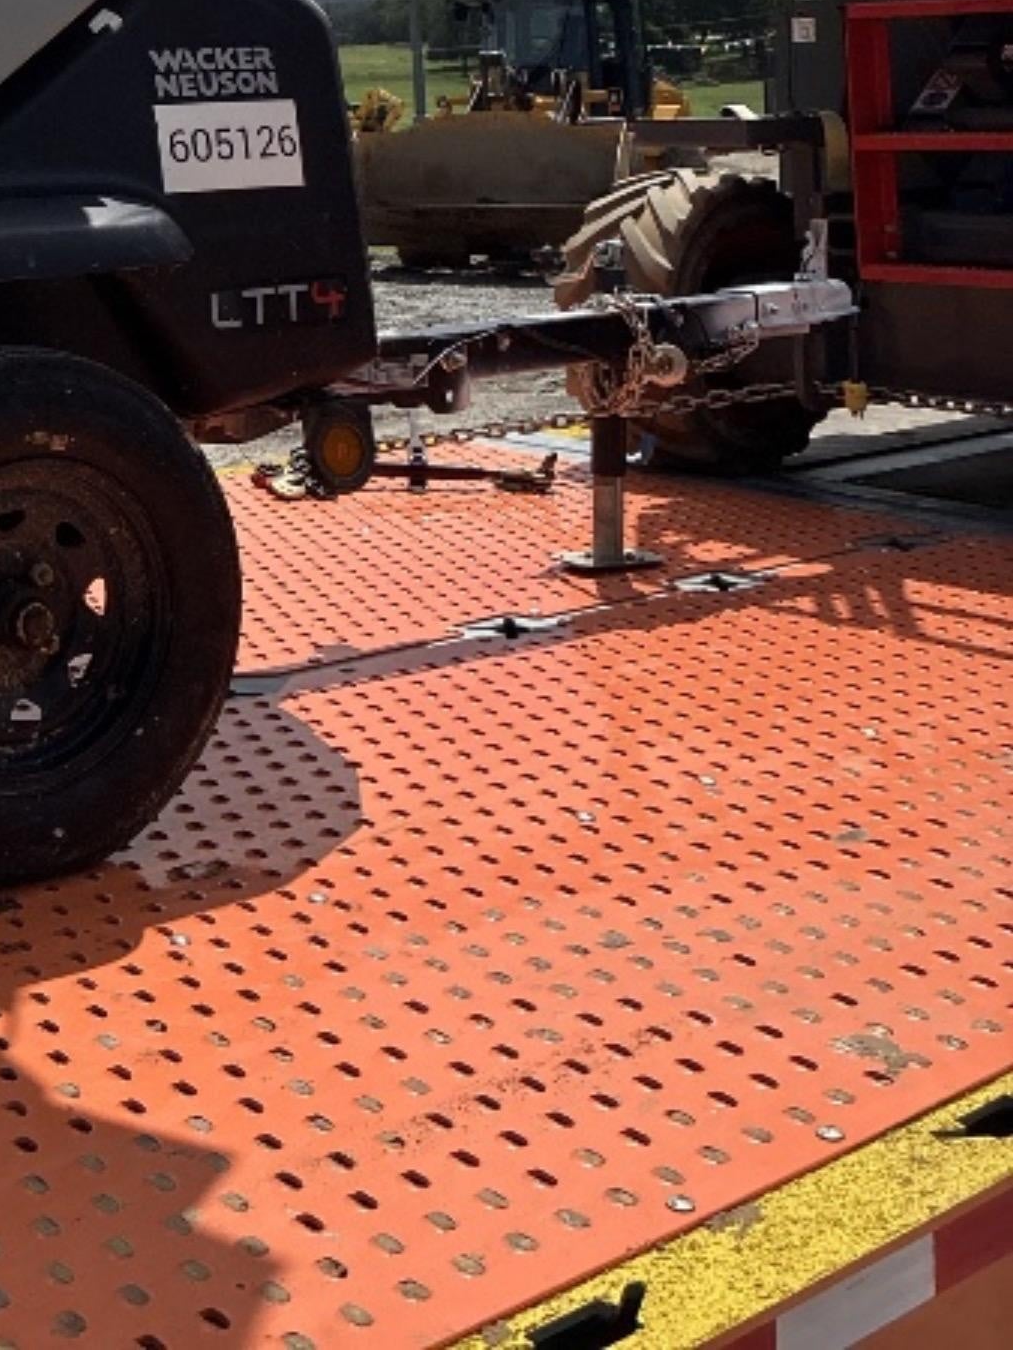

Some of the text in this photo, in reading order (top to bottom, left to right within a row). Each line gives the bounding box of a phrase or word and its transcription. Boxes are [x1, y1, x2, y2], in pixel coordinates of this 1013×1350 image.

[148, 47, 276, 73] WACKER
[154, 71, 280, 99] NEUSON
[168, 124, 298, 163] 605126
[210, 281, 346, 329] LTT4
